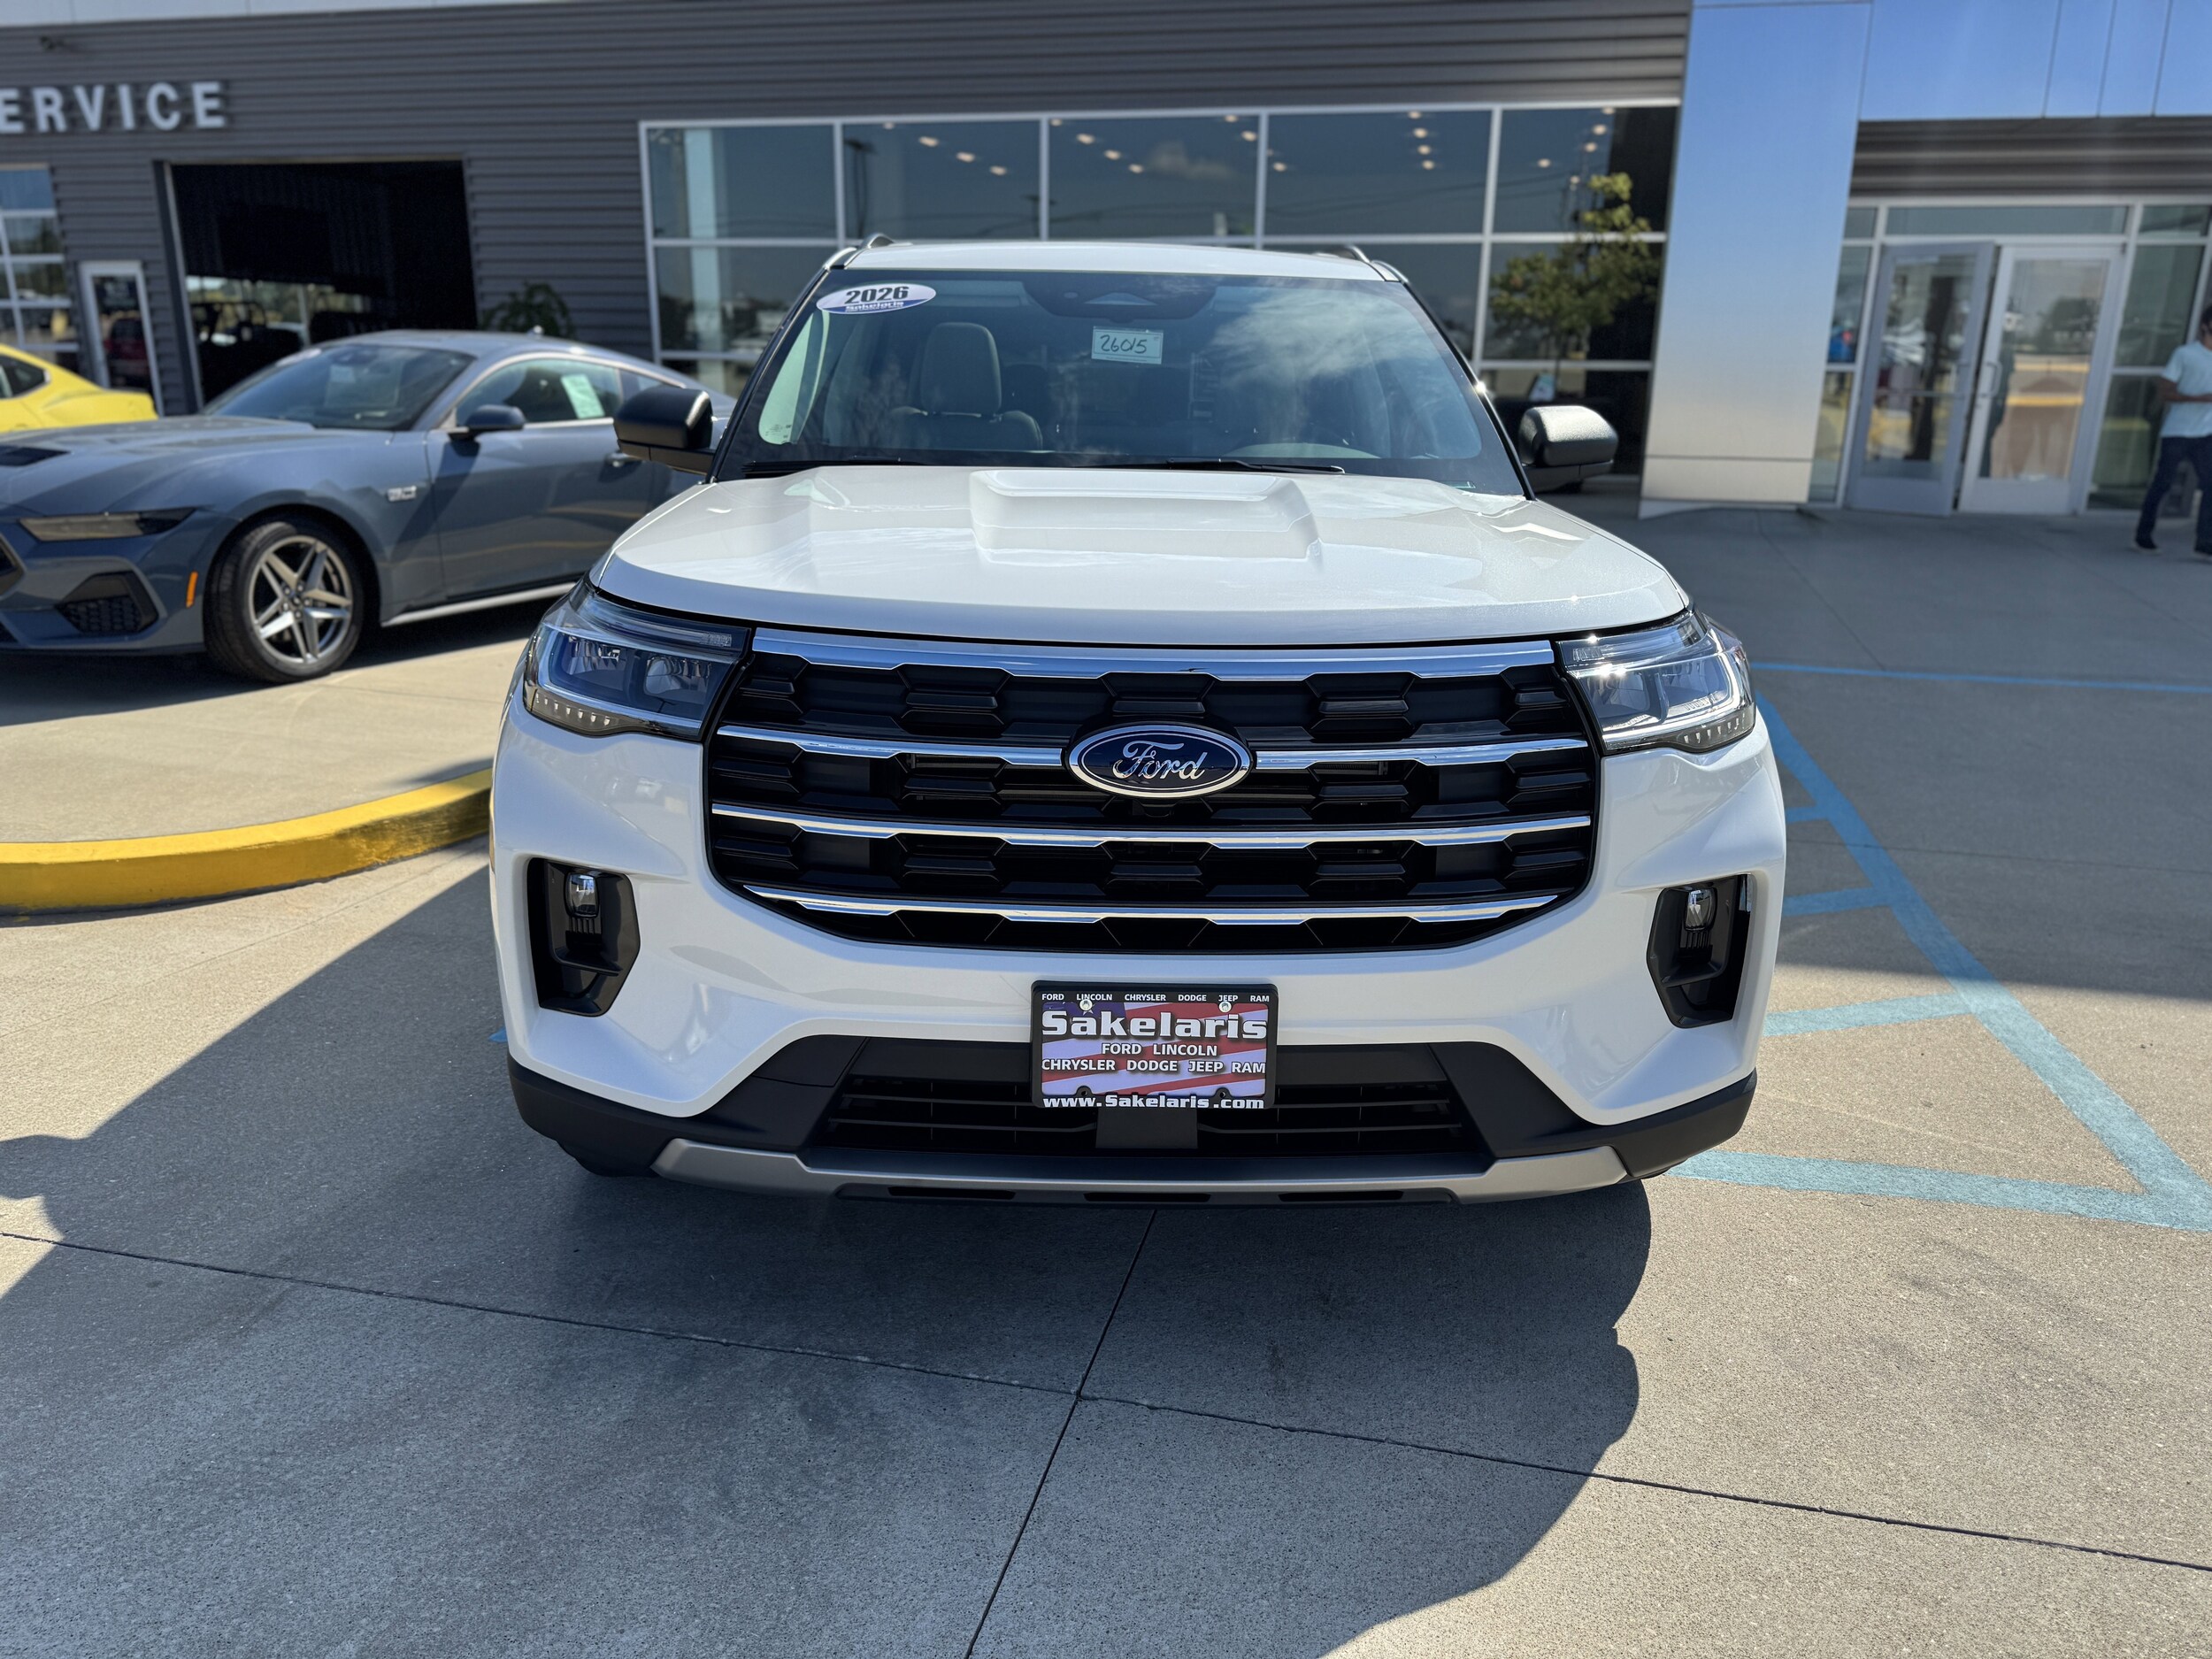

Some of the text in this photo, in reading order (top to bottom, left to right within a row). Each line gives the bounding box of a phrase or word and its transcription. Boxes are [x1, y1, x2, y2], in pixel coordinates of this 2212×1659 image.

[0, 81, 226, 132] ERVICE
[844, 286, 910, 304] 2026
[1100, 334, 1148, 354] 26015
[1112, 741, 1208, 780] Ford
[1041, 1010, 1267, 1040] Sakelaris
[1102, 1043, 1217, 1056] FORD LINCOLN
[1041, 1059, 1265, 1073] CHRYSLER DODGE JEEP RAM
